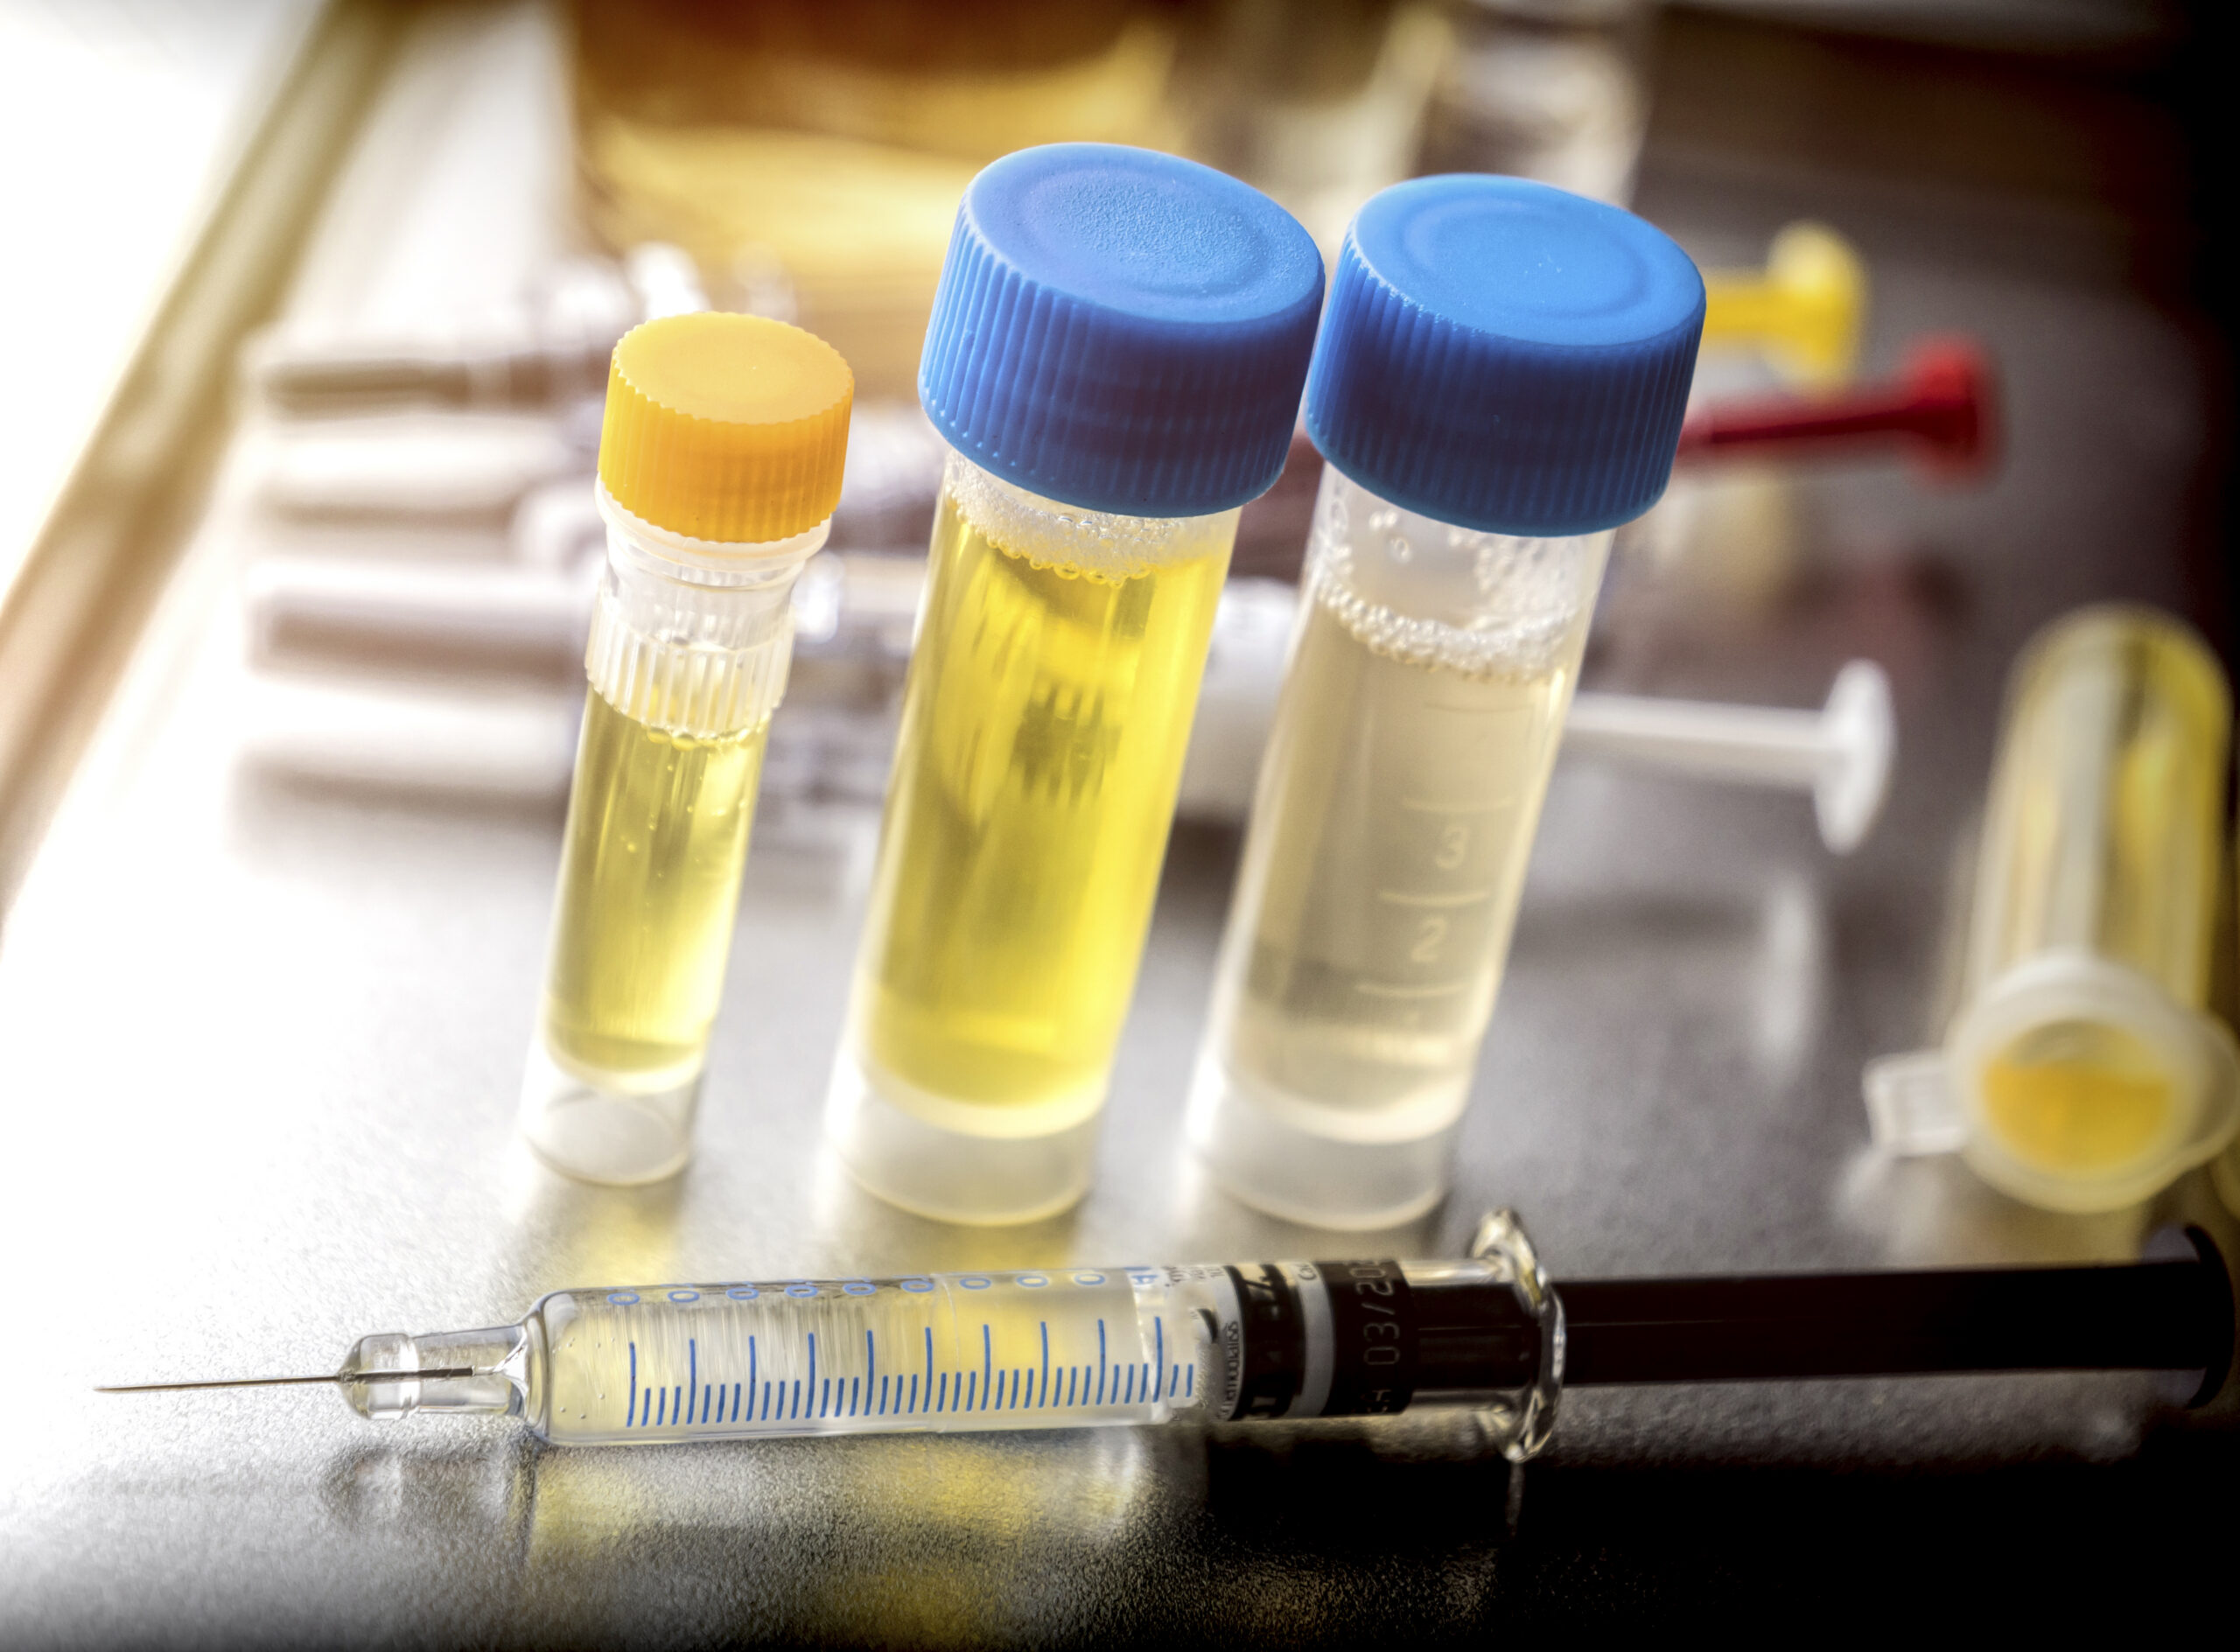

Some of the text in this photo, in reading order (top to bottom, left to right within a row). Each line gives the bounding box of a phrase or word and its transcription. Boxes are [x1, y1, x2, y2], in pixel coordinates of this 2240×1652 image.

[1435, 823, 1470, 870] 3
[1410, 916, 1447, 962] 2
[1348, 1262, 1400, 1366] 03/20
